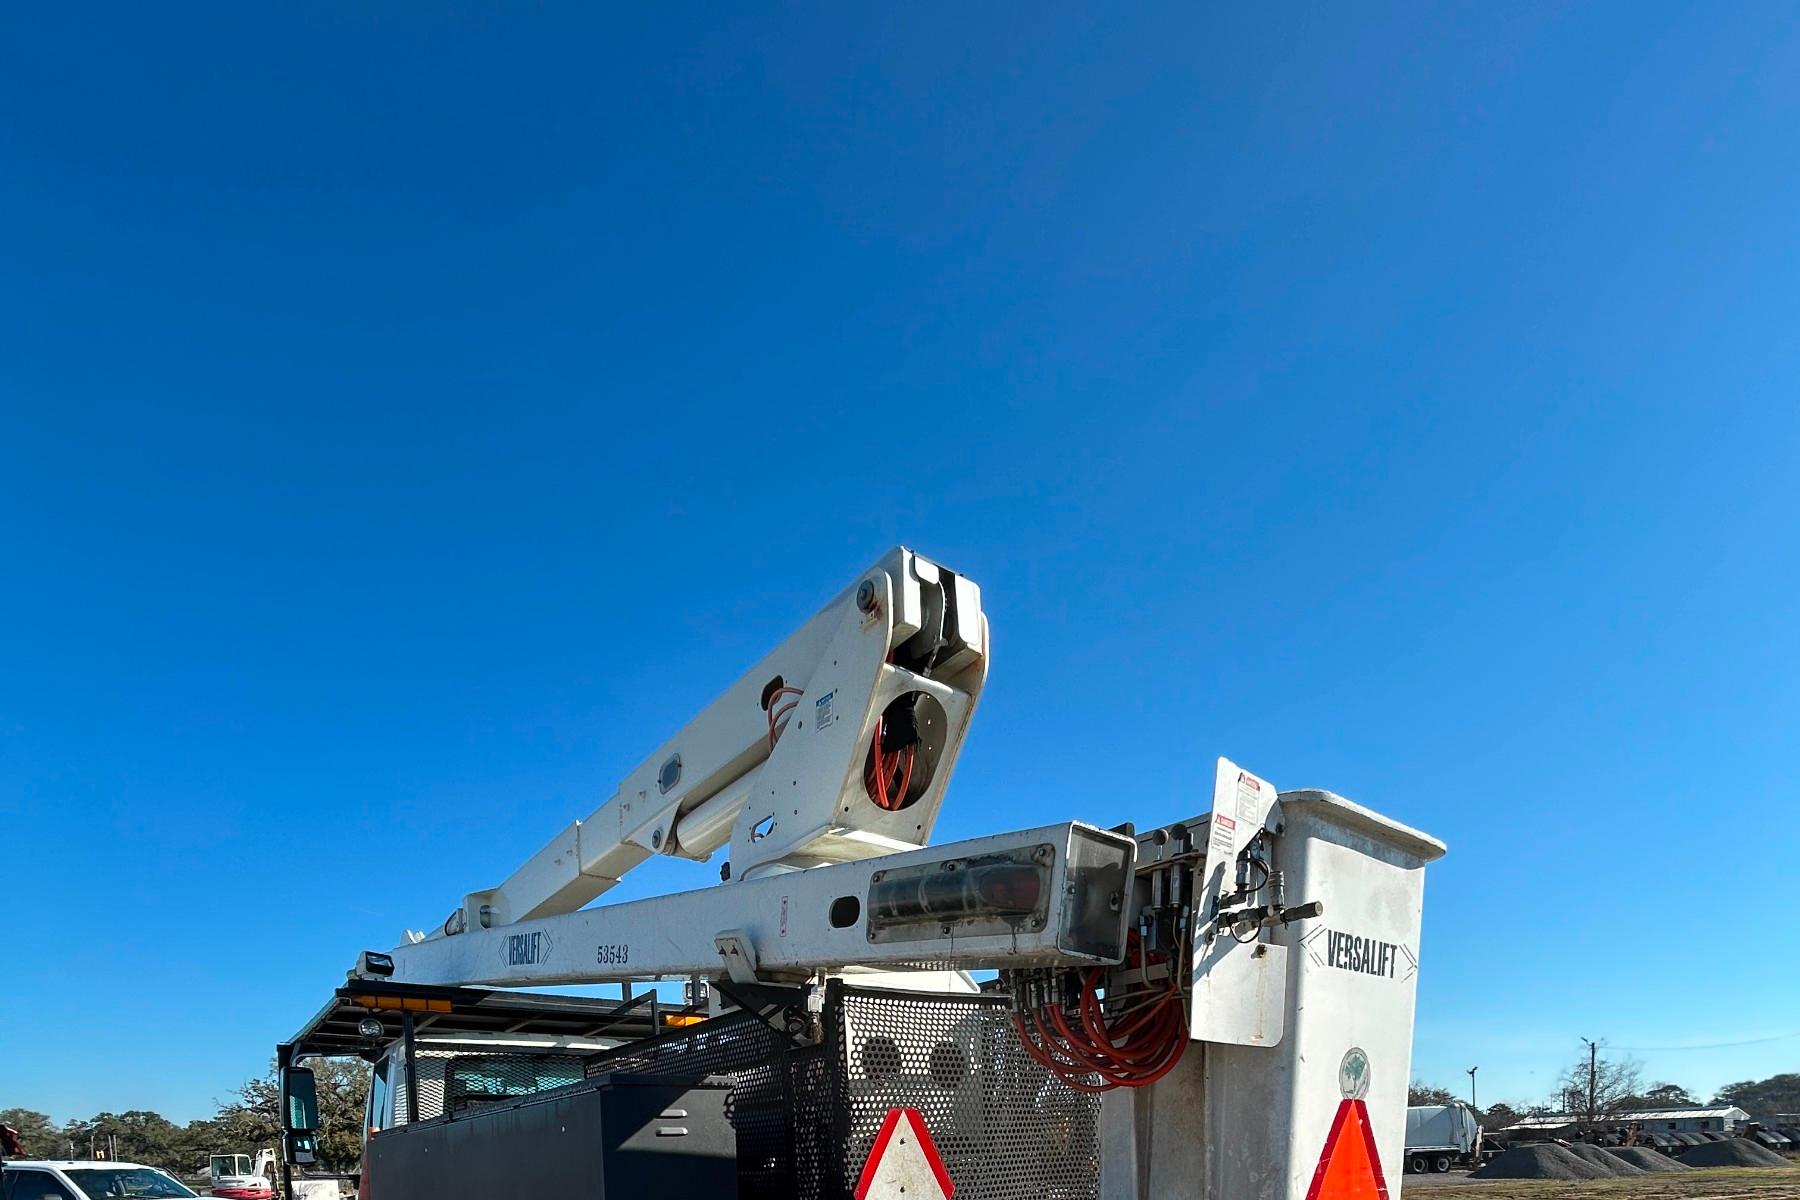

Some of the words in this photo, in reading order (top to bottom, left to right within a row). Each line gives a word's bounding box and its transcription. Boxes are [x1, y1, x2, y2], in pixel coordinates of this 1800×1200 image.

[508, 931, 541, 966] VERSALIFT
[597, 944, 628, 964] 53543
[1327, 929, 1398, 979] VERSALIFT
